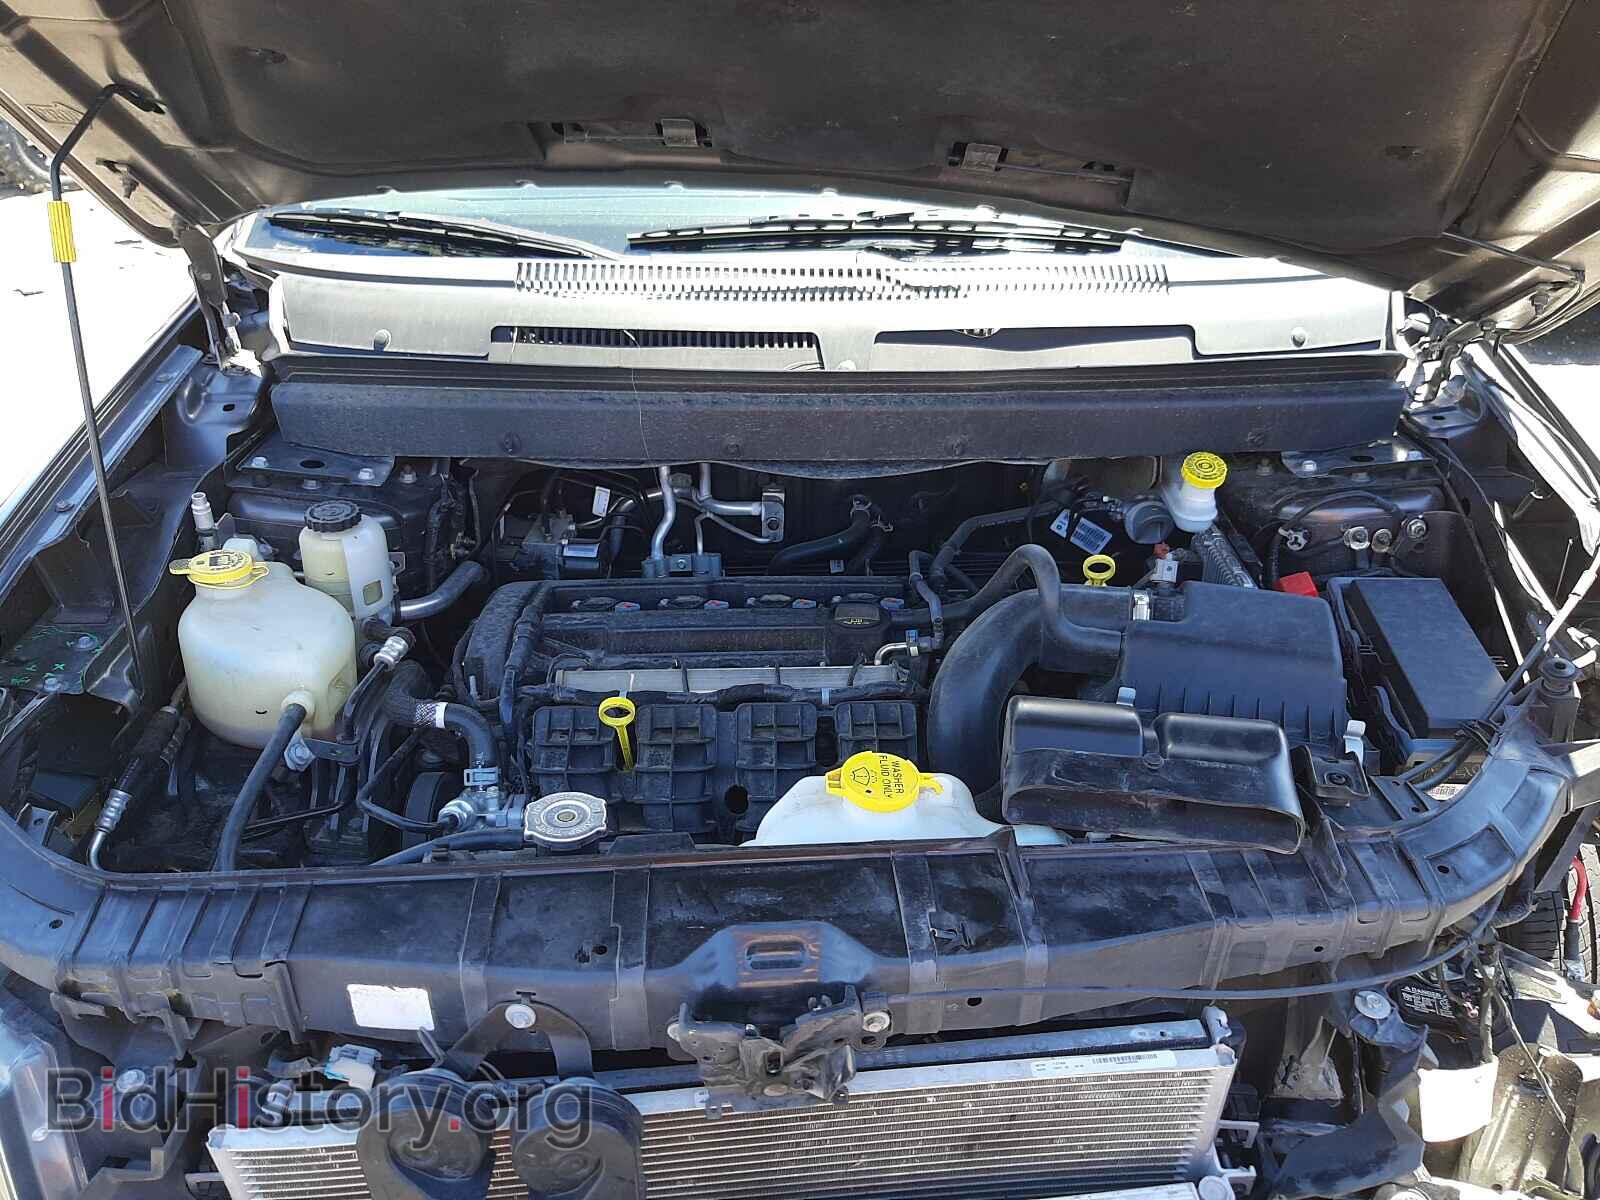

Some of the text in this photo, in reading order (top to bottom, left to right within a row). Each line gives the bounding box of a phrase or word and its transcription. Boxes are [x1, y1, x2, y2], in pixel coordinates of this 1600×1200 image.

[879, 755, 893, 799] FLUID ONLY
[891, 760, 905, 794] WASHER
